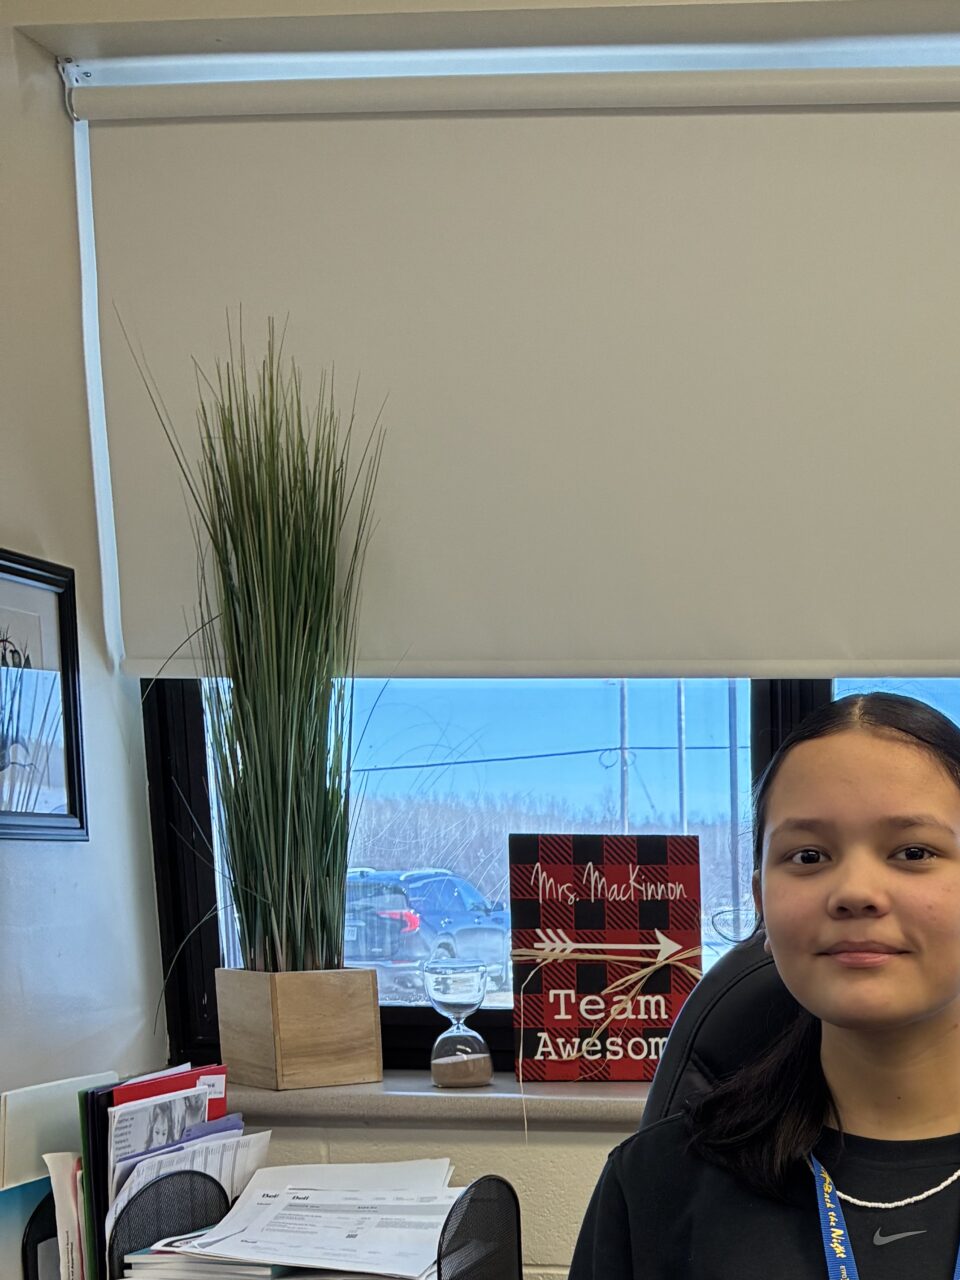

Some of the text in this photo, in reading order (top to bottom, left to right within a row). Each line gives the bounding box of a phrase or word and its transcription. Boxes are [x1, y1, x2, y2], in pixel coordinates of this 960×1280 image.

[530, 861, 687, 905] Mrs. MacKinnon
[549, 989, 668, 1021] Team
[828, 1211, 837, 1226] the
[830, 1228, 847, 1259] Night
